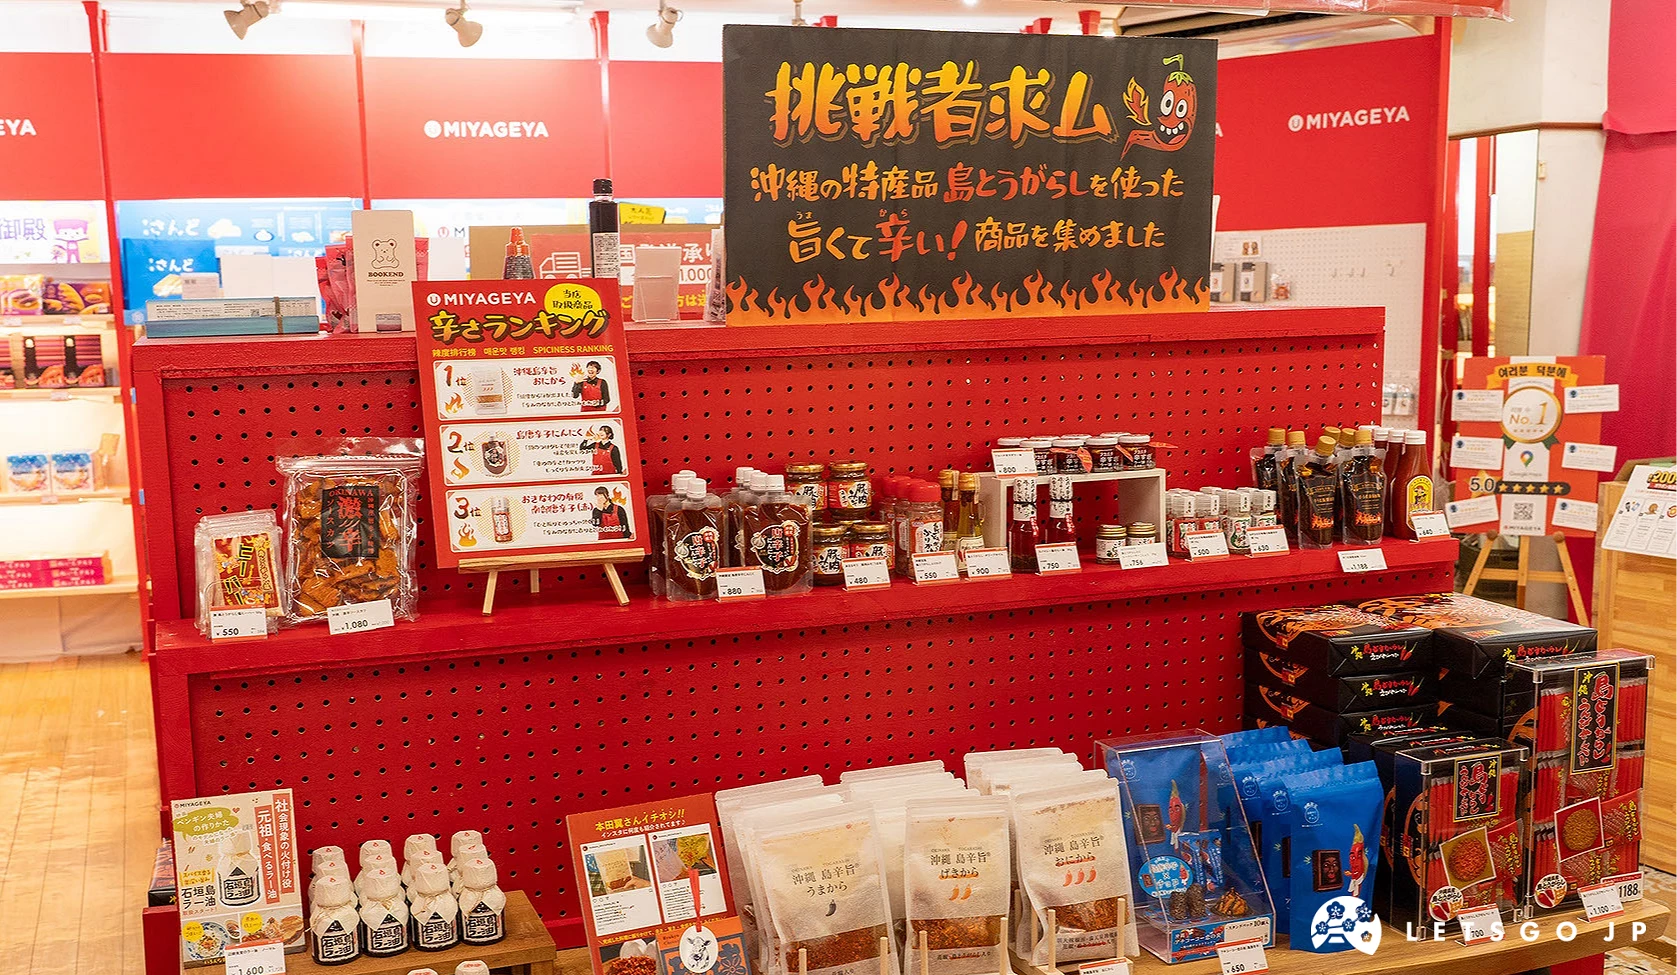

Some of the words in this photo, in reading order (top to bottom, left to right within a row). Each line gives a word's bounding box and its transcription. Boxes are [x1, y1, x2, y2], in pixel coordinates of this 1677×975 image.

[765, 60, 1118, 148] 挑戦者求ム
[1305, 106, 1410, 130] MIYAGEYA
[443, 121, 549, 138] MIYAGEYA
[443, 291, 536, 306] MIYAGEYA
[429, 308, 610, 344] 辛さランキング
[532, 345, 576, 354] SPICINESS
[576, 344, 615, 353] RANKING
[1498, 365, 1528, 378] 여러분
[1536, 365, 1567, 378] 덕분에
[532, 377, 567, 386] おにから
[1470, 478, 1495, 492] 5.0
[329, 488, 374, 497] OKINAWA
[180, 800, 212, 808] MIYAGEYA
[193, 819, 230, 832] の作りかた
[275, 799, 293, 889] 社会現象の火付け役
[1043, 842, 1066, 856] 沖縄
[930, 854, 951, 866] 沖縄
[1055, 851, 1097, 867] おにから
[791, 871, 817, 886] 沖縄
[940, 866, 979, 879] げきから
[181, 884, 216, 899] 石垣島
[807, 881, 848, 898] うまから
[182, 896, 217, 910] ラー油
